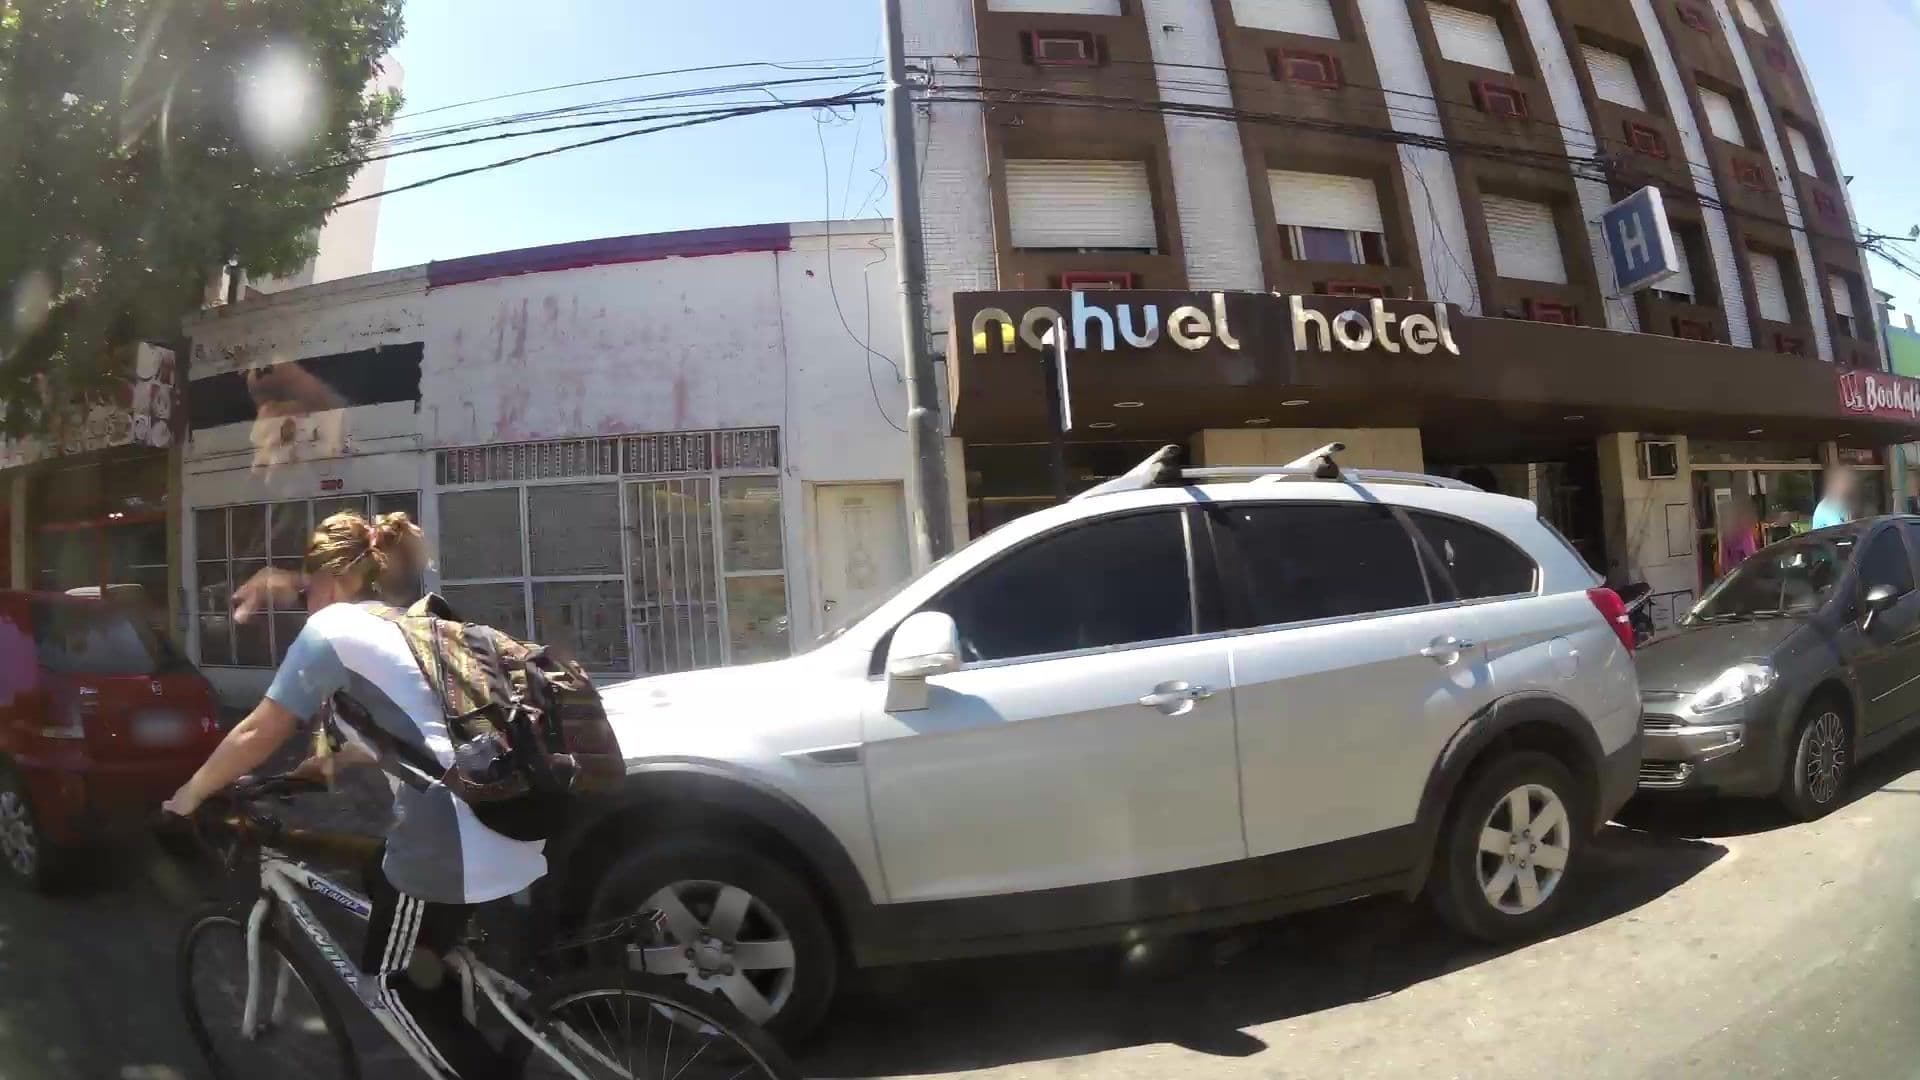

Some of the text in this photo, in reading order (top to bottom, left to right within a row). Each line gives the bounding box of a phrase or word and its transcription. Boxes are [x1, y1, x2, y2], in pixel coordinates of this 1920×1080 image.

[1618, 212, 1650, 271] H
[971, 291, 1241, 355] nahuel
[1289, 295, 1460, 355] hotel
